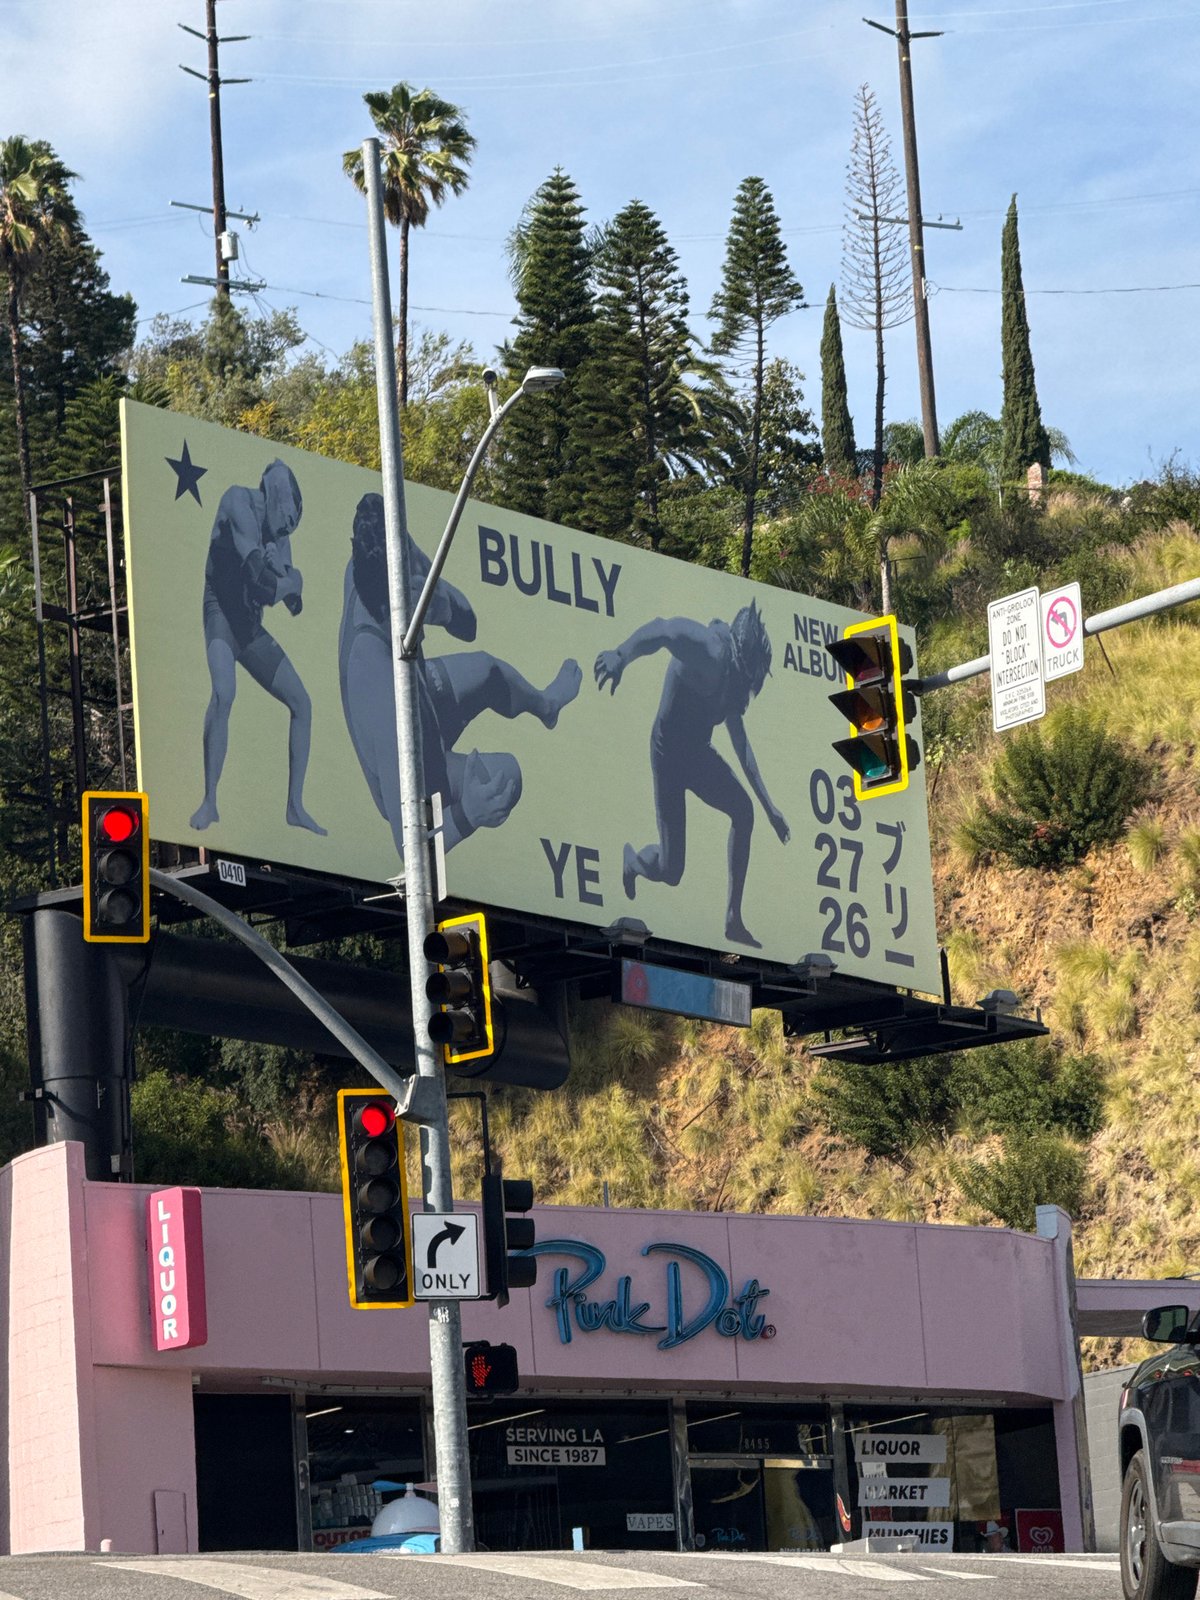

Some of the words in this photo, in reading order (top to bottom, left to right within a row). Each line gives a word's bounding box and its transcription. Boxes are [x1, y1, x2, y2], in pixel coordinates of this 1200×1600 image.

[477, 525, 622, 618] BULLY
[992, 596, 1035, 619] ANTI-GRIDLOCK
[1006, 613, 1022, 626] ZONE
[793, 612, 839, 647] NEW
[1002, 630, 1012, 646] DO
[1016, 625, 1027, 643] NOT
[783, 642, 847, 685] ALBU
[1005, 646, 1027, 665] BLOCK
[1047, 648, 1080, 673] TRUCK
[996, 659, 1039, 688] INTERSECTION
[809, 768, 862, 831] 03
[220, 861, 244, 883] 0410
[539, 837, 605, 907] YE
[814, 832, 864, 893] 27
[875, 820, 914, 968] ブリー
[818, 896, 871, 959] 26
[157, 1200, 179, 1340] LIQUOR
[421, 1272, 471, 1291] ONLY
[512, 1238, 668, 1345] Pink
[506, 1427, 577, 1443] SERVING
[582, 1428, 604, 1443] LA
[861, 1439, 921, 1456] LIQUOR
[514, 1449, 560, 1463] SINCE
[565, 1449, 599, 1463] 1987
[865, 1485, 928, 1500] MARKET
[628, 1516, 674, 1529] VAPES
